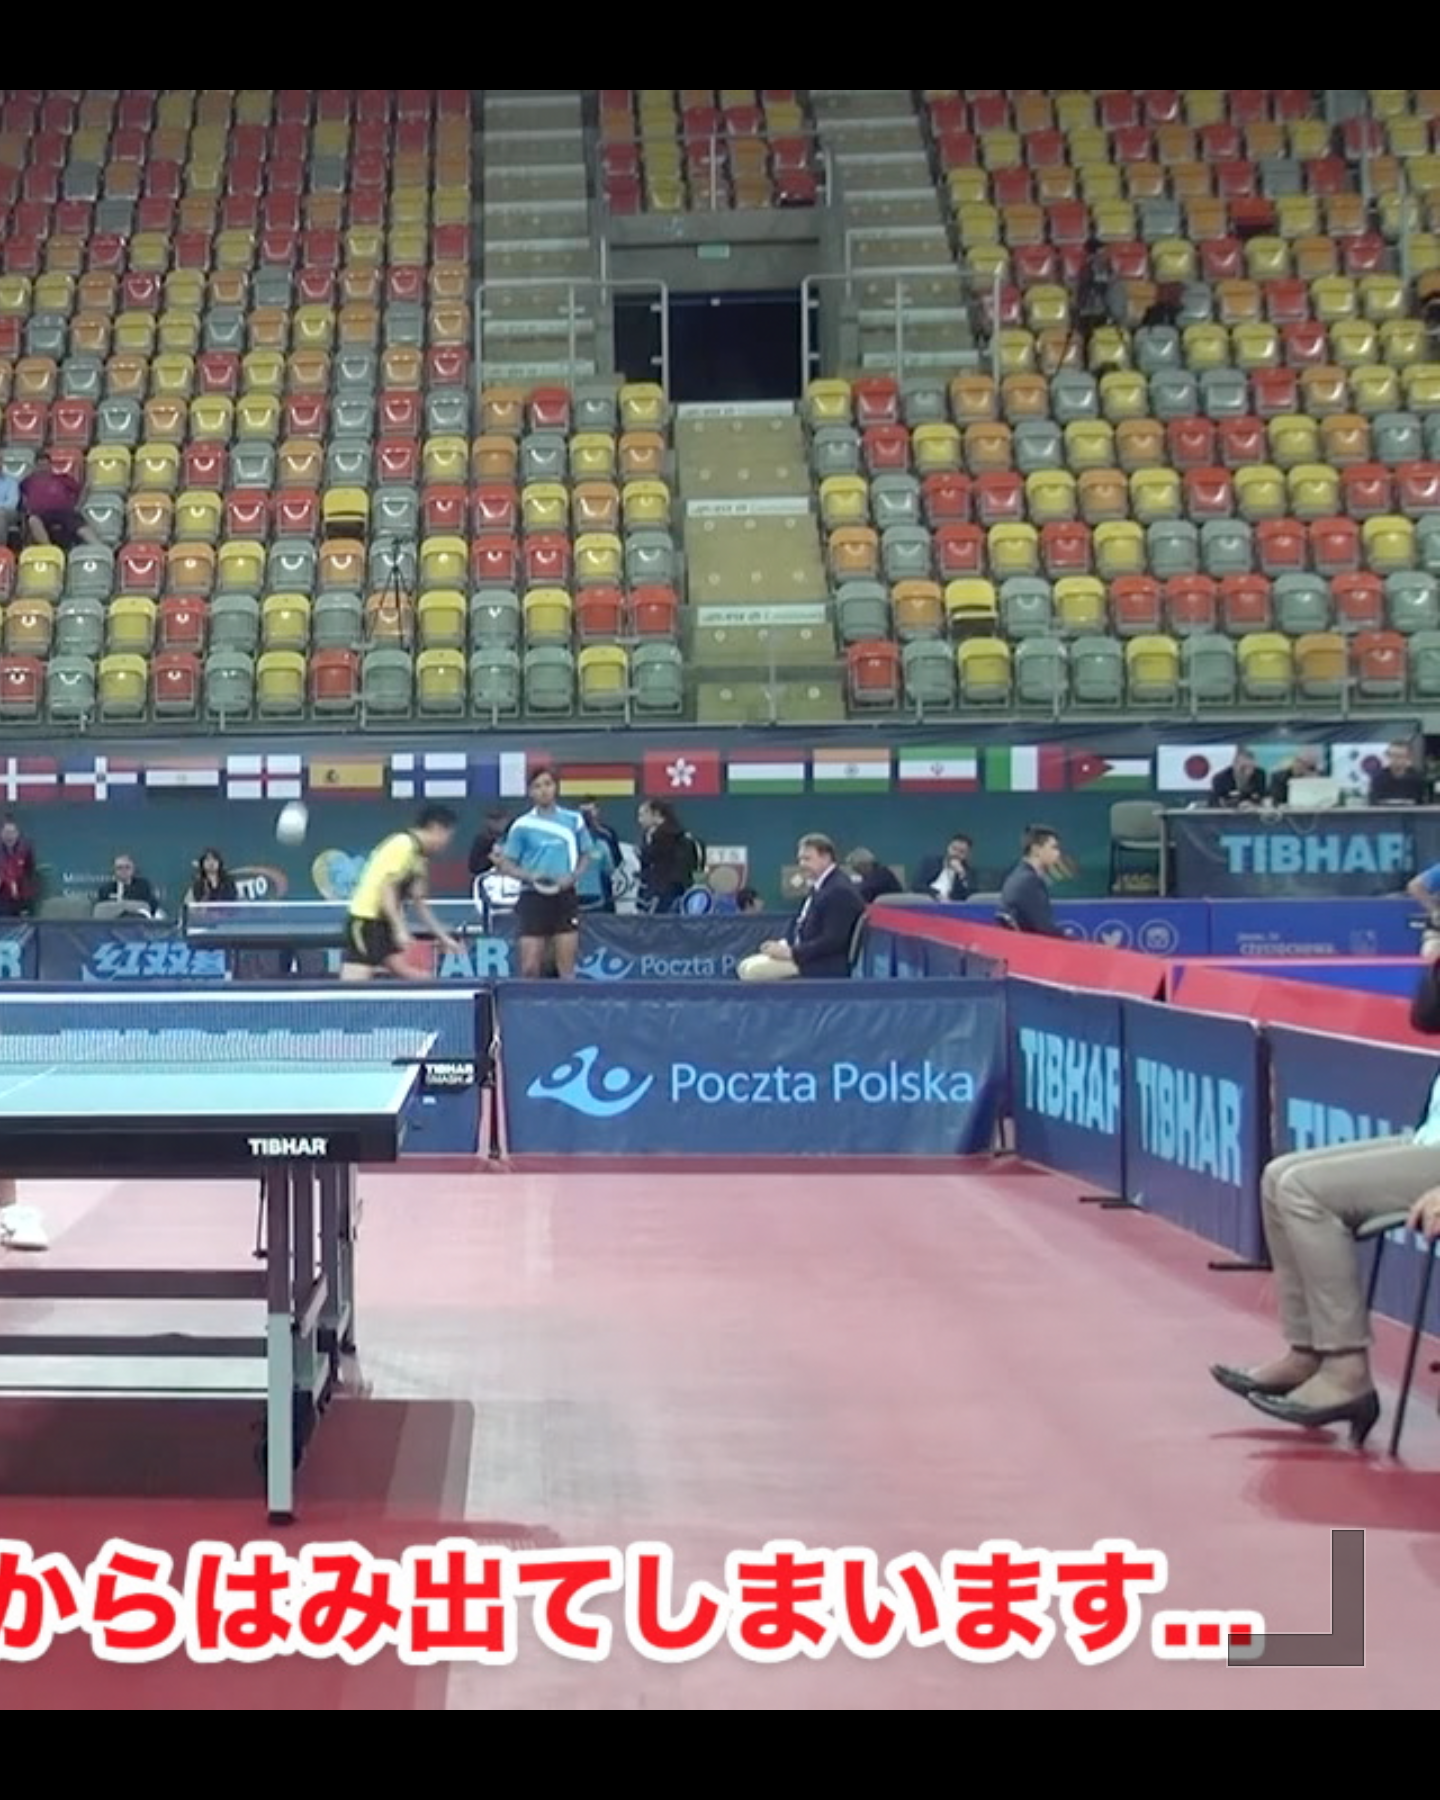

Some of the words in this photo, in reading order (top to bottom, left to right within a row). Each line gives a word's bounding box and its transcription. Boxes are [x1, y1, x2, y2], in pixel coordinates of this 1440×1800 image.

[640, 955, 714, 976] Poczta
[671, 1062, 817, 1103] Poczta
[833, 1060, 974, 1103] Polska
[1136, 1057, 1243, 1188] TIBHAR
[247, 1137, 329, 1156] TIBHAR
